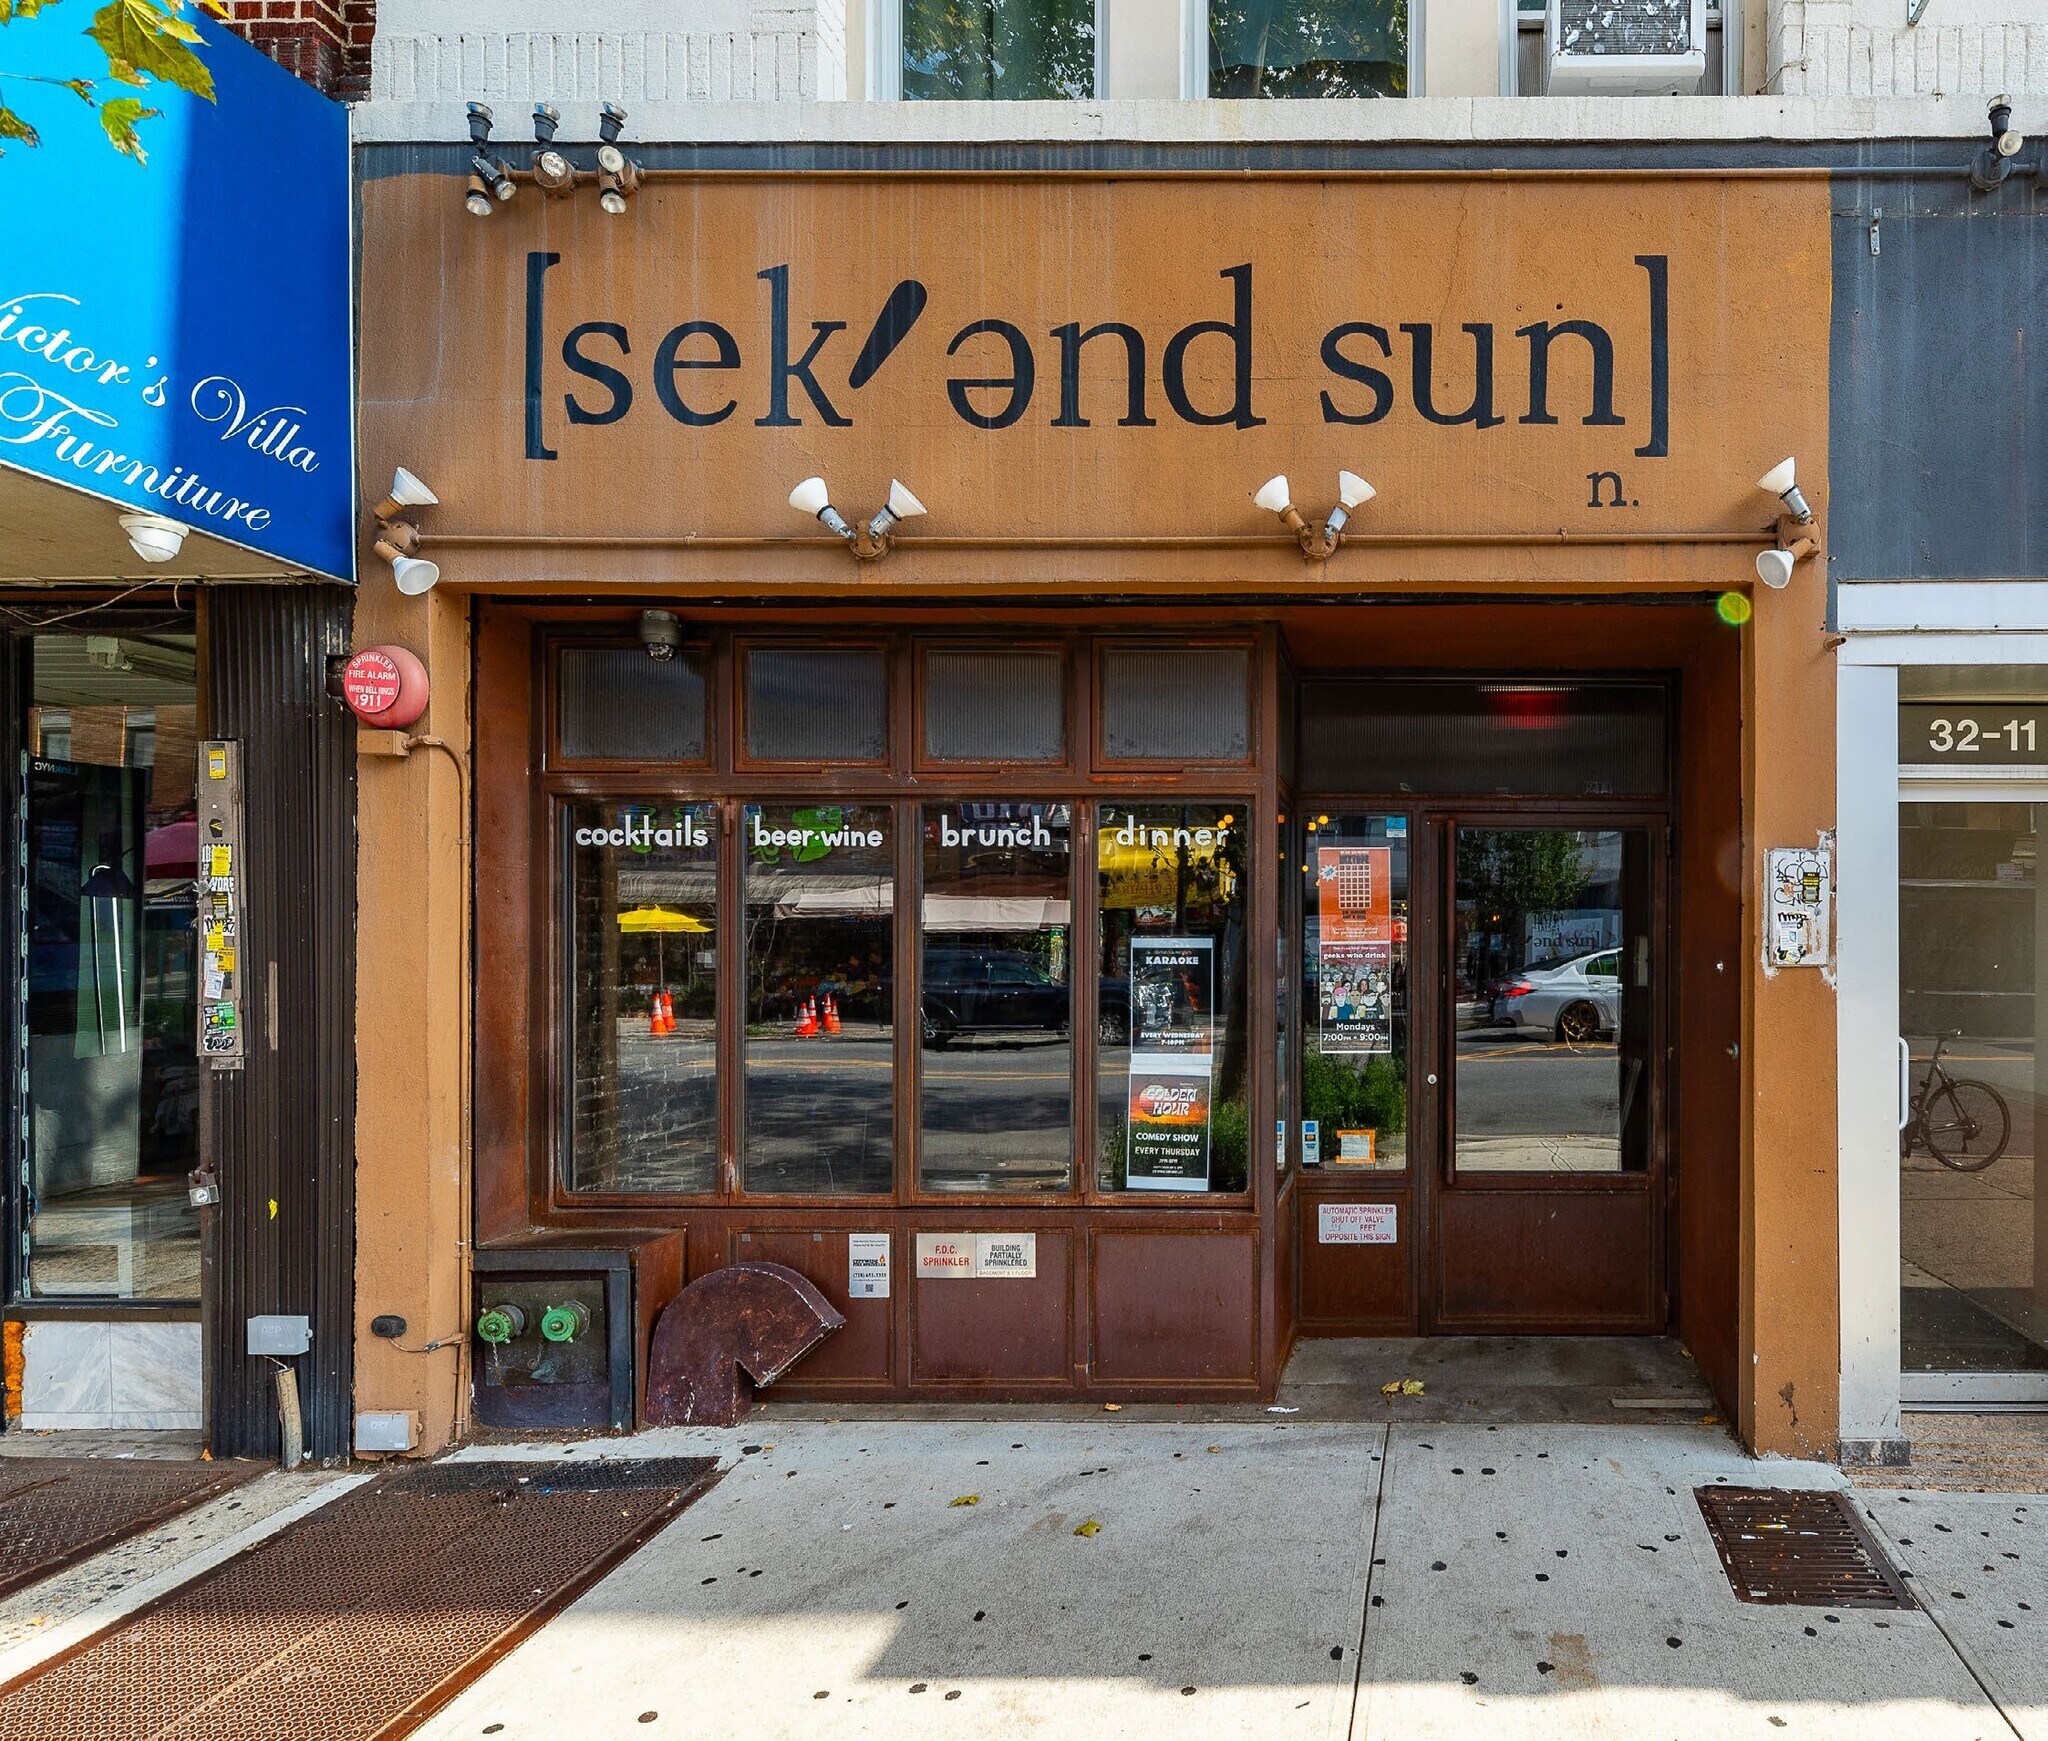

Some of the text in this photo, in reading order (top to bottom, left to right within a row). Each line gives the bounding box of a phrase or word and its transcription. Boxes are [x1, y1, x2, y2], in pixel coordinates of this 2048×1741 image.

[190, 375, 321, 473] Villa
[0, 371, 272, 532] Furniture
[1587, 470, 1640, 509] n.
[352, 653, 393, 671] SPRINKLER
[349, 670, 396, 680] FIRE ALARM
[348, 684, 366, 694] WHEN
[365, 685, 378, 695] BELL
[360, 694, 381, 707] 911
[1929, 718, 2036, 752] 32-11
[575, 814, 709, 847] cocktails
[941, 814, 1051, 847] brunch
[1116, 814, 1230, 847] dinner
[1145, 956, 1199, 965] KARAOKE
[1336, 1022, 1375, 1032] Mondays
[1146, 1087, 1197, 1102] GOLDEN
[1152, 1102, 1191, 1116] HOUR
[1135, 1132, 1199, 1142] COMEDY SHOW
[1134, 1146, 1200, 1157] EVERY THURSDAY
[1322, 1207, 1394, 1215] AUTOMATIC SPRINKLER
[1331, 1215, 1348, 1223] SHUT
[1360, 1224, 1376, 1232] FEET
[1325, 1233, 1391, 1241] OPPOSITE THIS SIGN
[935, 1245, 957, 1255] F.D.C.
[991, 1244, 1021, 1252] BUILDING
[989, 1251, 1023, 1259] PARTIALLY
[923, 1256, 970, 1267] SPRINKLER
[984, 1259, 1028, 1267] SPRINKLERED
